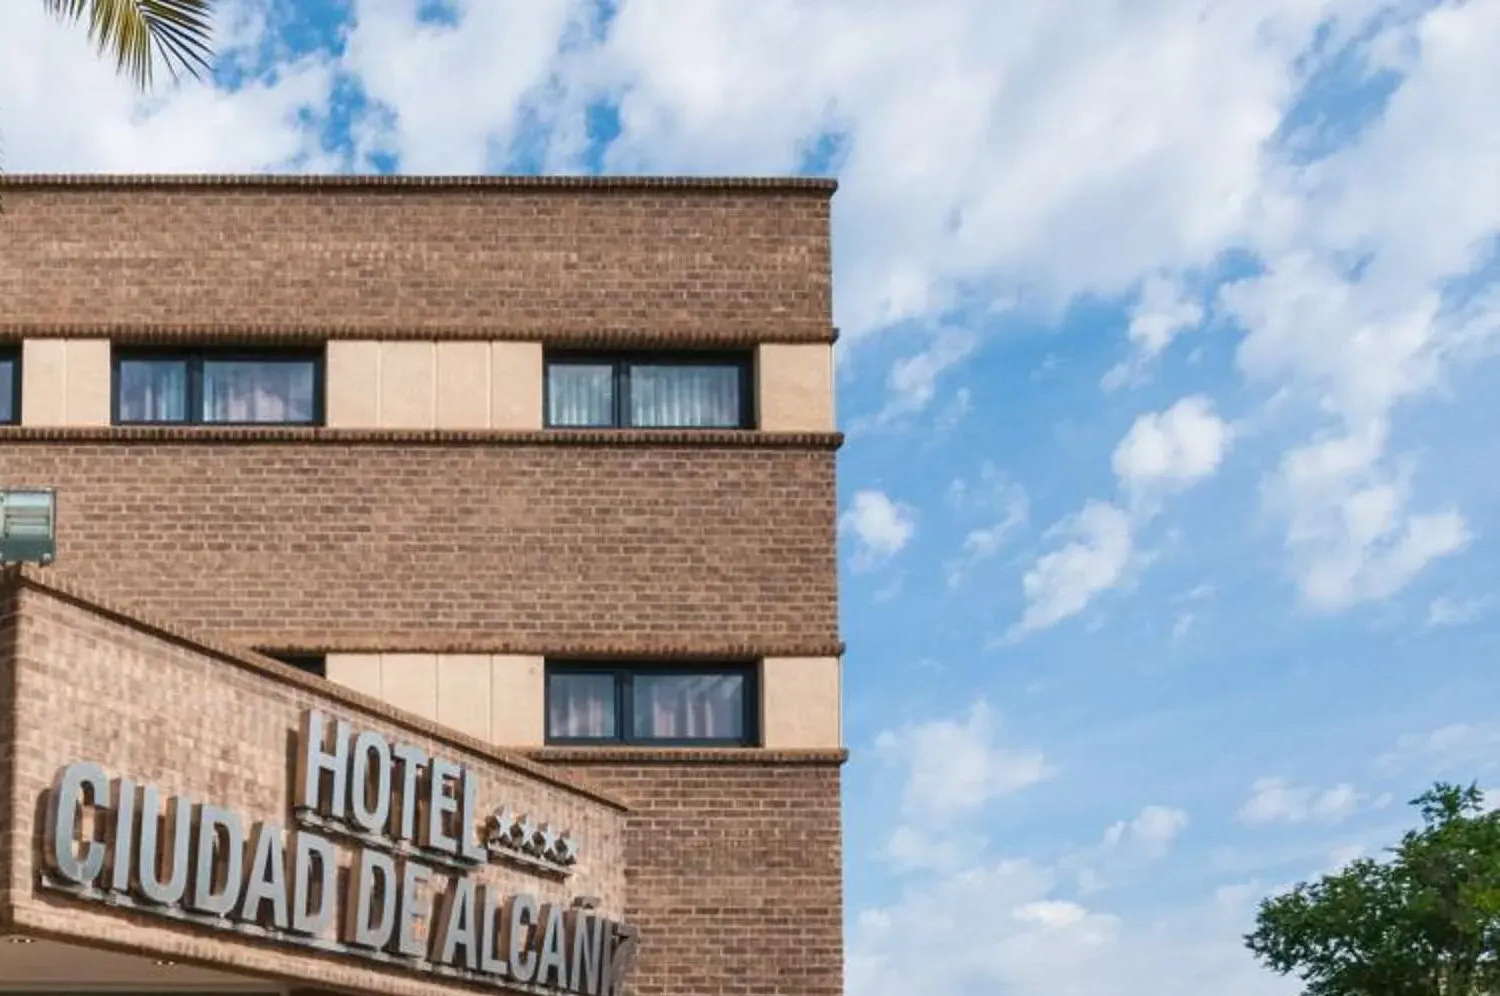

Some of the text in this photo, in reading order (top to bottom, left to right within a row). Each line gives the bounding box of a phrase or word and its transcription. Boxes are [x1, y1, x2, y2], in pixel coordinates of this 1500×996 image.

[50, 761, 337, 937] CIUDAD
[356, 849, 433, 957] DE
[305, 709, 487, 863] HOTEL
